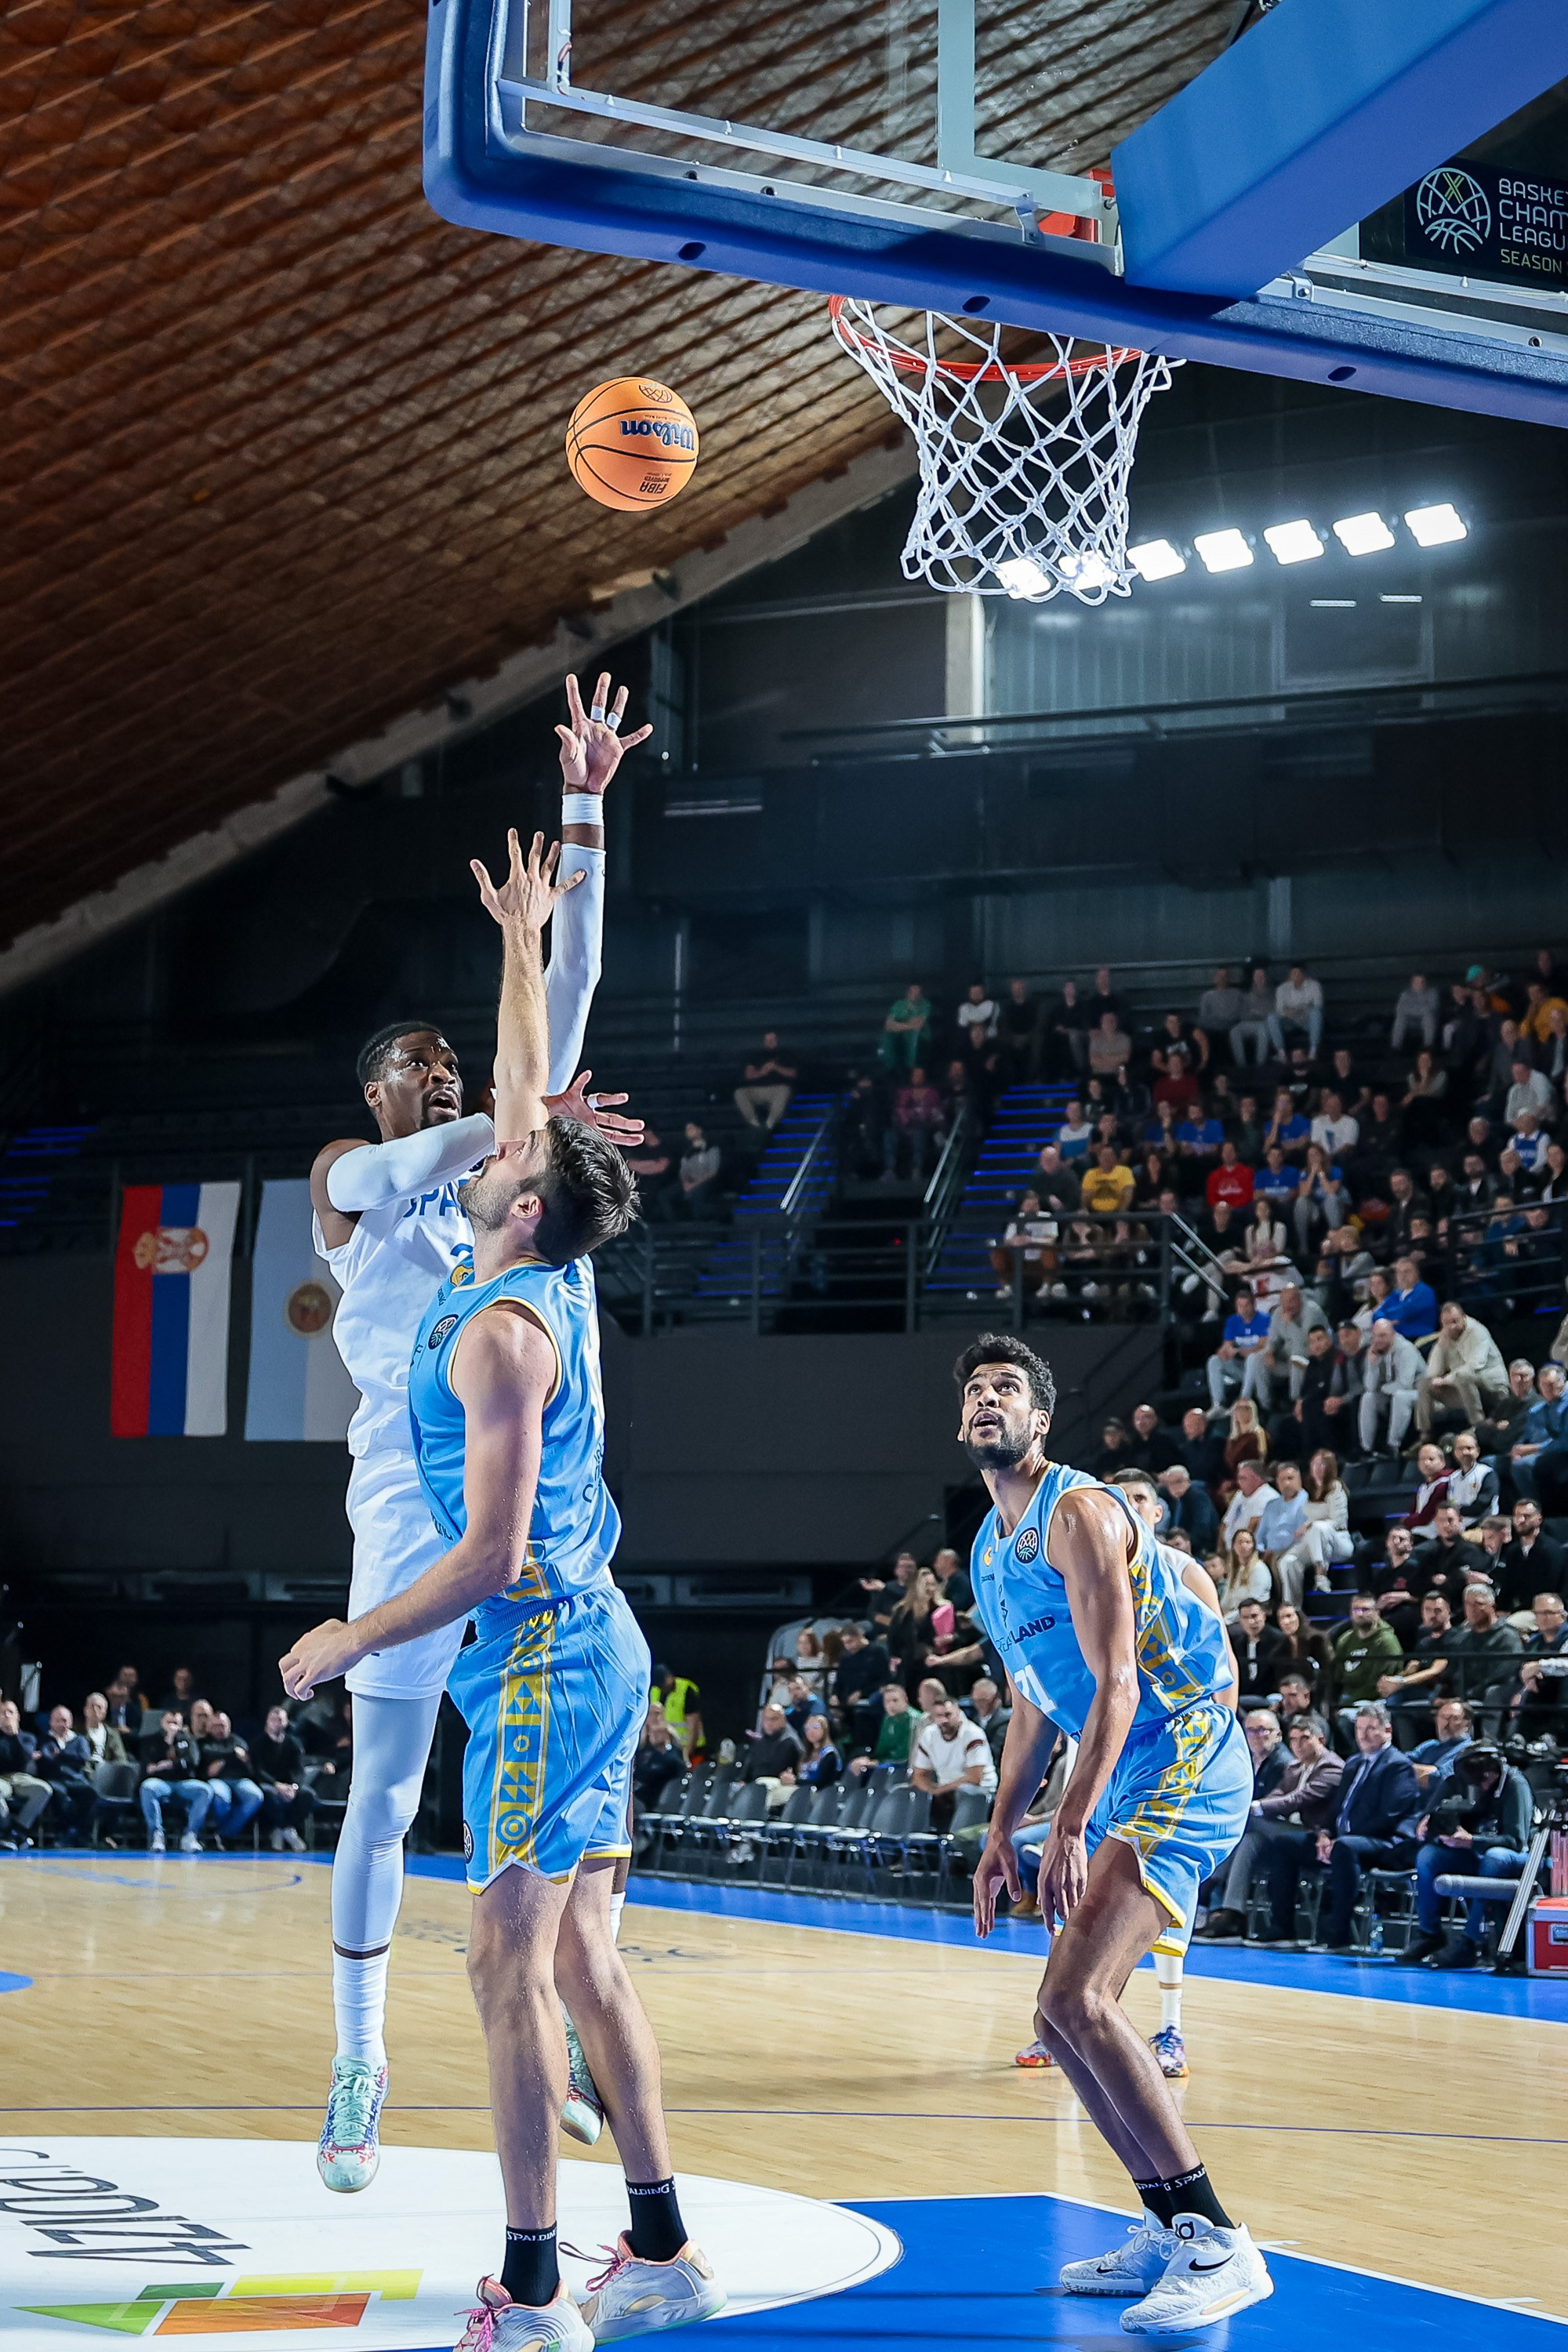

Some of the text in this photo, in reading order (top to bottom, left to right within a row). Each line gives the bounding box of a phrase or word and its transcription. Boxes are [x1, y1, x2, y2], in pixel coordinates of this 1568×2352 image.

[1499, 178, 1568, 206] BASKE
[1500, 223, 1568, 251] LEAGU
[1501, 249, 1563, 274] SEASON
[619, 419, 695, 451] Wilson
[639, 481, 666, 494] FIBA
